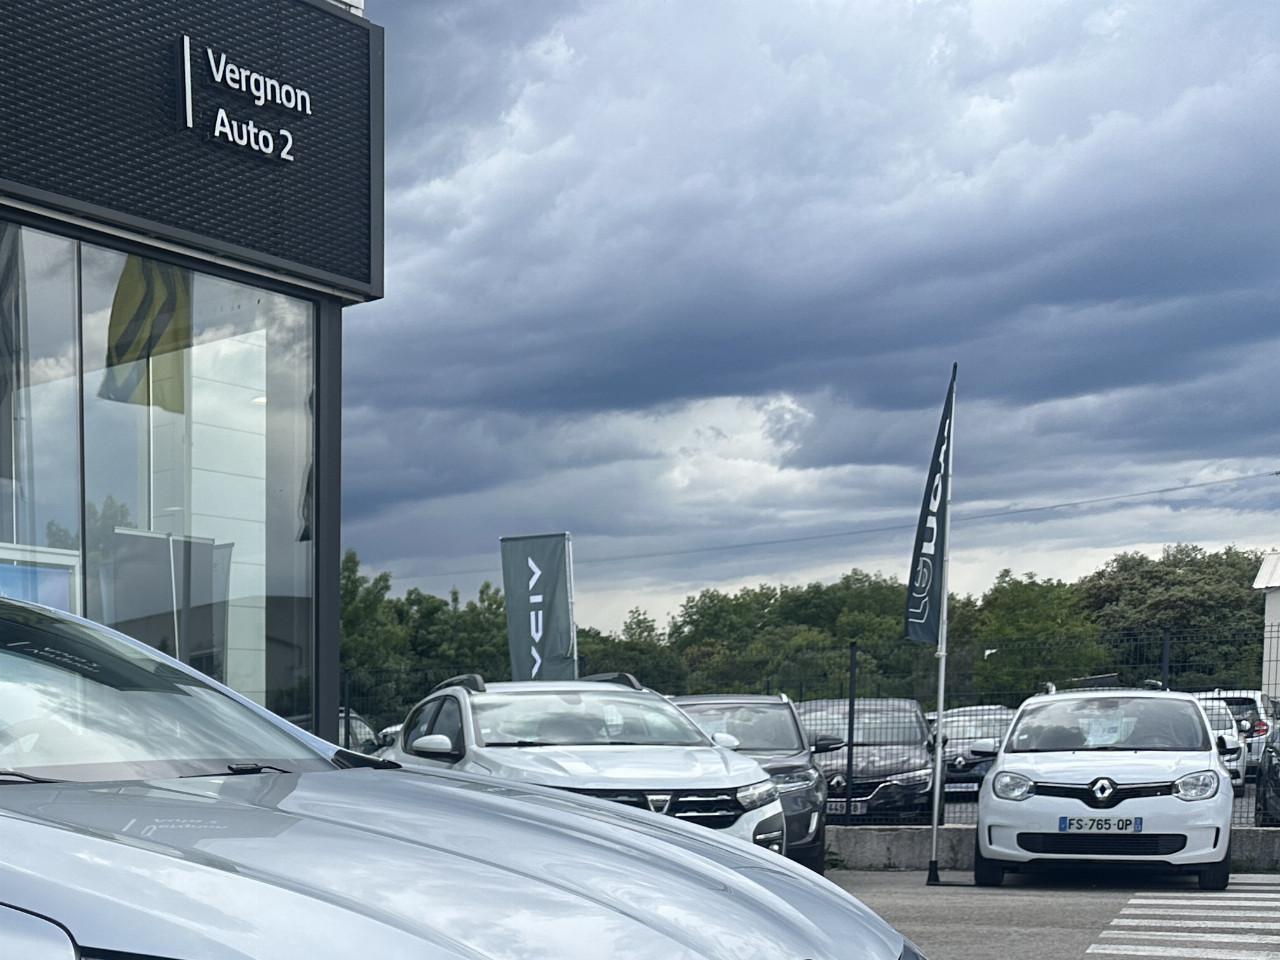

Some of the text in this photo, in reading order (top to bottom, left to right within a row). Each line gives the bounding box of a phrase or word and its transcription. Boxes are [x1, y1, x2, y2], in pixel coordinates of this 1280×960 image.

[207, 47, 312, 115] Vergnon
[214, 108, 295, 161] Auto 2
